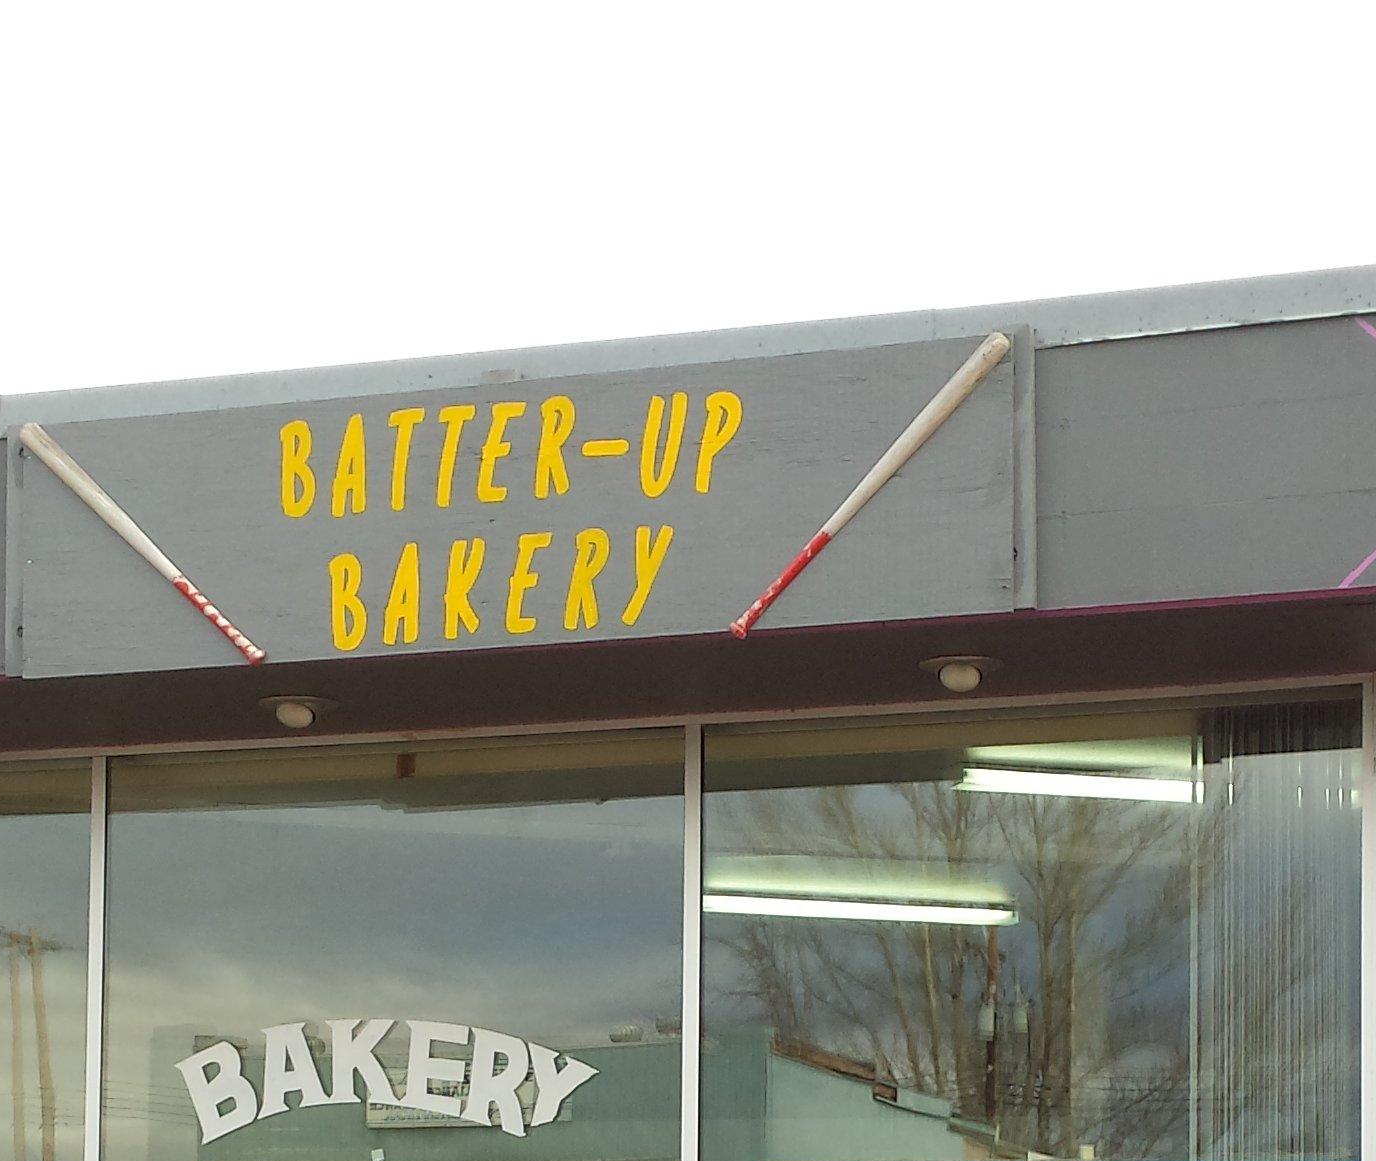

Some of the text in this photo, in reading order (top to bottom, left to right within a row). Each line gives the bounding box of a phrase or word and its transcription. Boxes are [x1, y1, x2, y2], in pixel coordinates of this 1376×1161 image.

[279, 391, 743, 518] BATTER-UP
[329, 525, 674, 651] BAKERY
[174, 1018, 600, 1145] BAKERY
